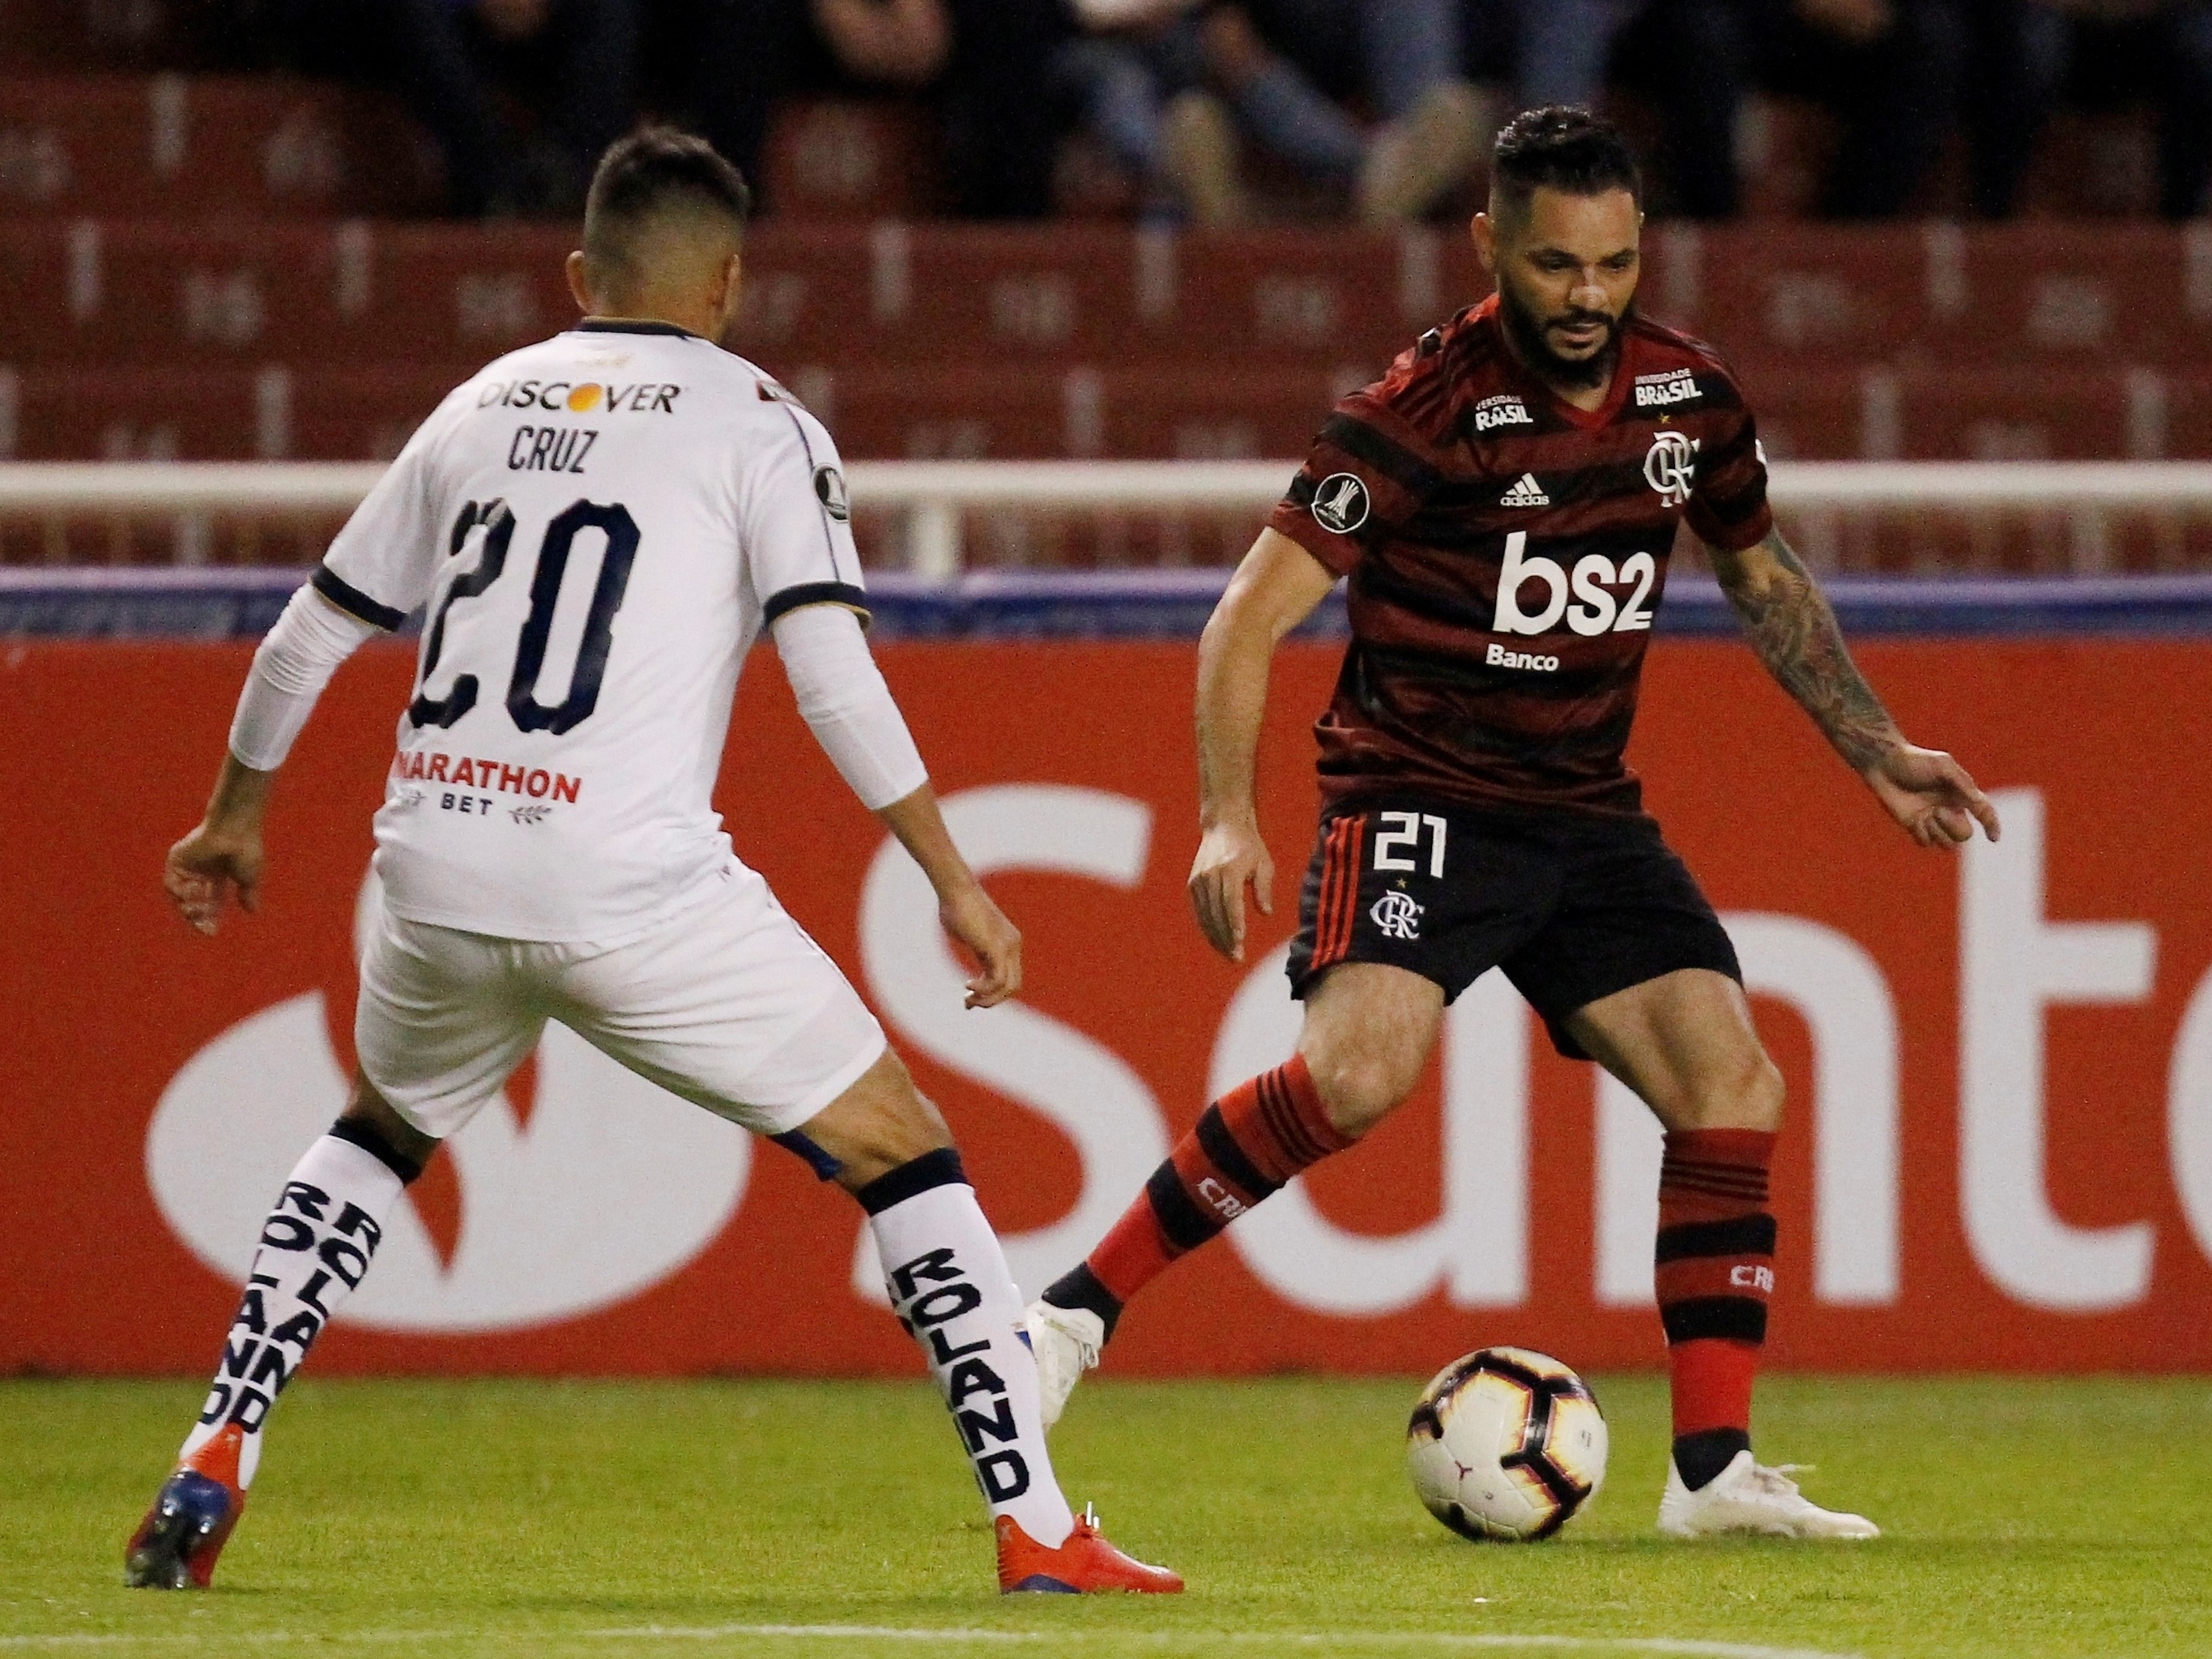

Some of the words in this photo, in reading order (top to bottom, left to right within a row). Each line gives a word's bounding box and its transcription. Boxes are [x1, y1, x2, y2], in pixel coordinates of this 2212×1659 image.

[477, 379, 682, 414] DISCOVER
[1635, 378, 1703, 407] BRASIL
[507, 424, 599, 474] CRUZ
[1500, 494, 1550, 507] adidas
[1491, 531, 1656, 638] bs2
[408, 497, 641, 736] 20
[1485, 643, 1559, 673] Banco
[440, 792, 493, 816] BET
[1374, 811, 1448, 879] 21
[852, 783, 2212, 1311] Sant
[227, 1201, 381, 1434] ROLAND
[891, 1247, 1030, 1504] ROLAND
